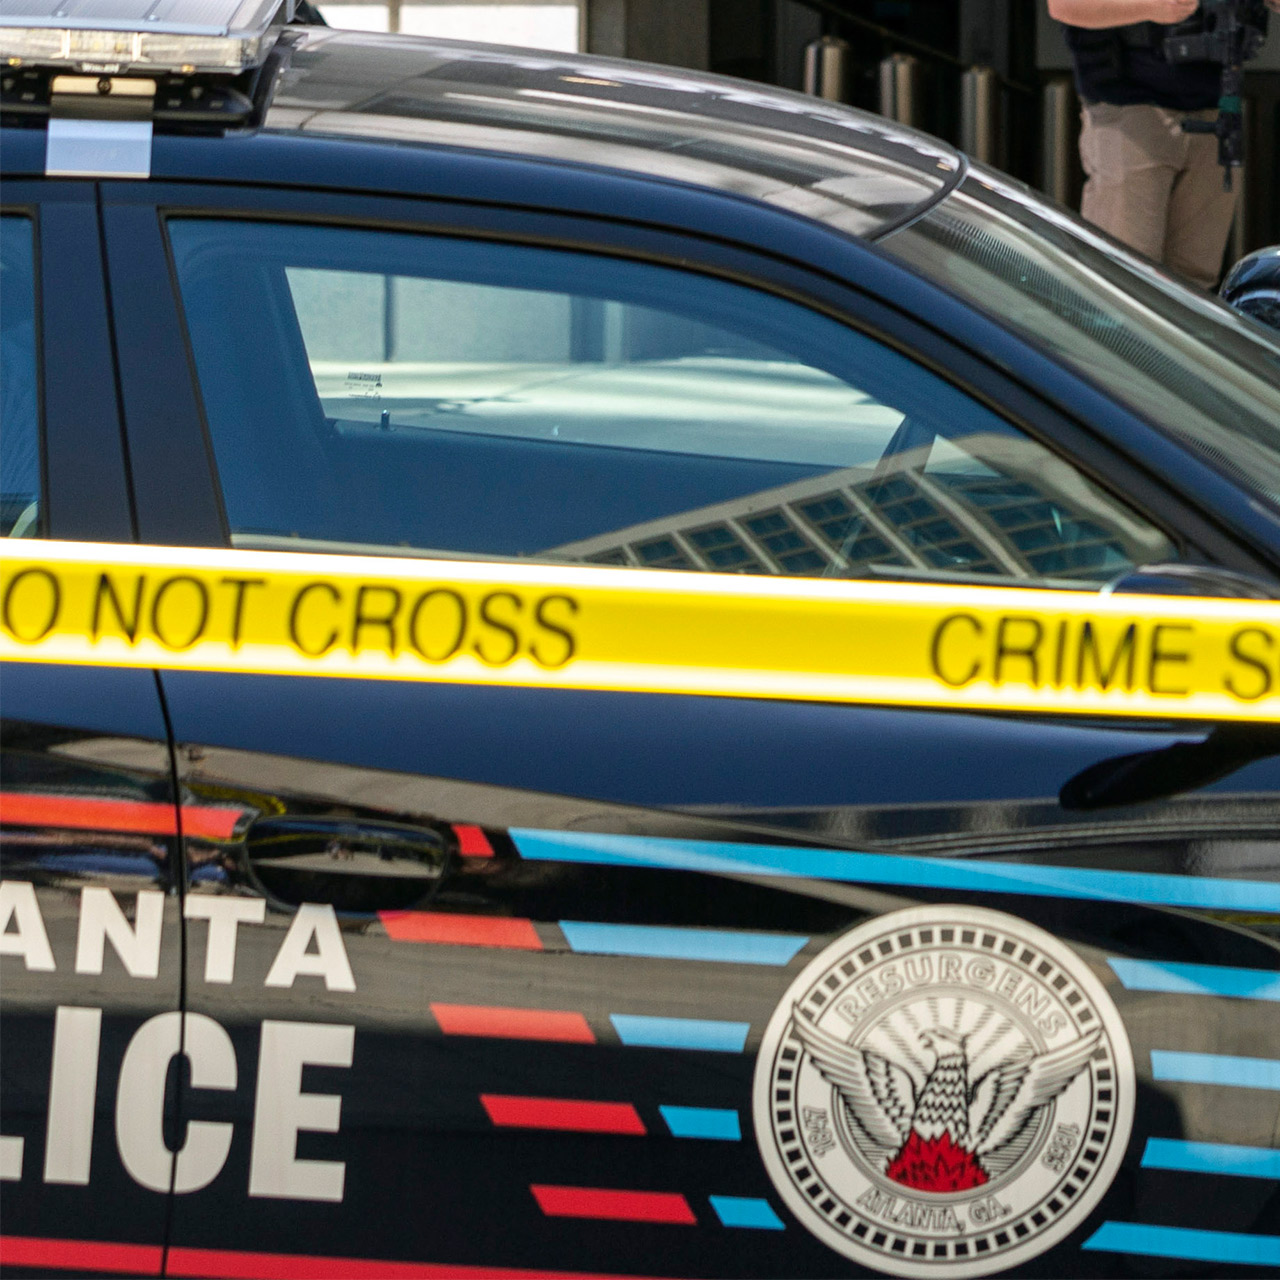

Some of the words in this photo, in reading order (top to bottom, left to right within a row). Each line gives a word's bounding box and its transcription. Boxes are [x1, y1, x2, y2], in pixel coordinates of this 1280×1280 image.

[91, 573, 268, 651] NOT
[287, 581, 581, 668] CROSS
[930, 613, 1195, 696] CRIME
[834, 952, 1069, 1040] RESURGENS
[856, 1186, 967, 1233] ATLANTA,
